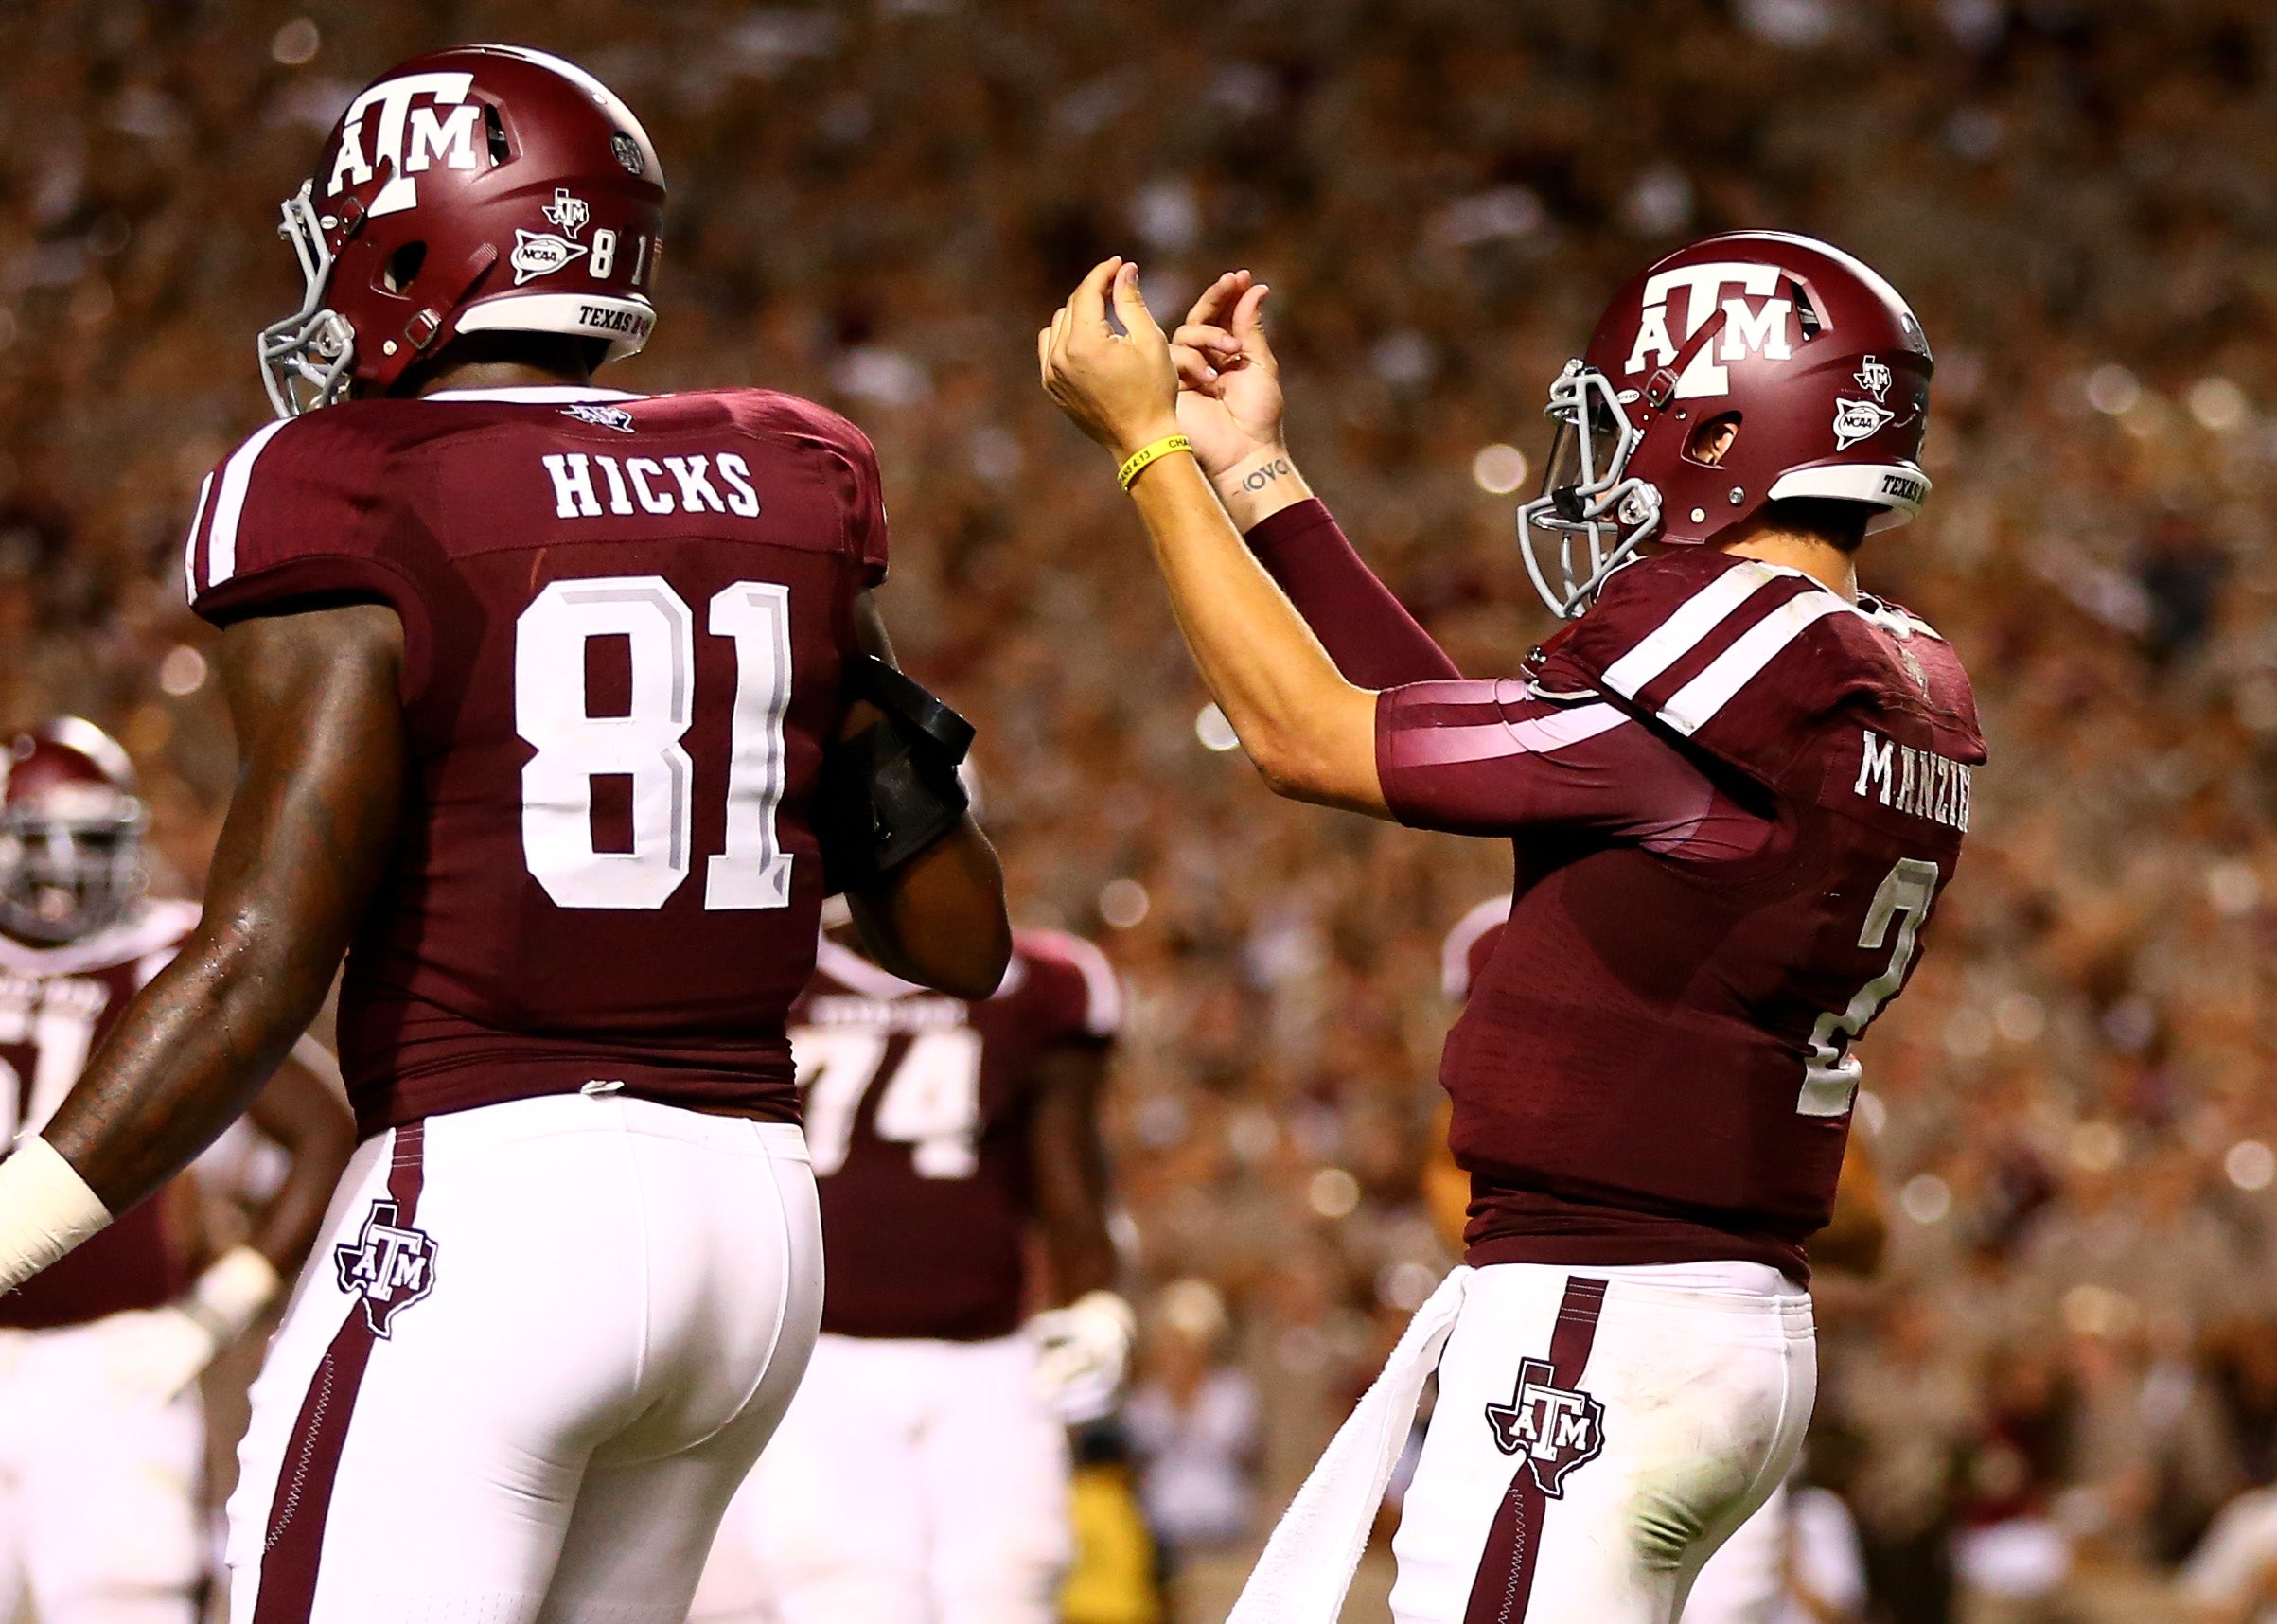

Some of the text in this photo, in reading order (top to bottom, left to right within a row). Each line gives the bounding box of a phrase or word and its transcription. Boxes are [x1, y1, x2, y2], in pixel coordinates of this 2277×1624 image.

[521, 248, 558, 262] NCAA
[579, 305, 632, 332] TEXAS
[1843, 415, 1873, 429] NCAA
[542, 450, 761, 520] HICKS
[1881, 474, 1920, 503] TEXAS
[515, 574, 795, 910] 81
[1796, 857, 1938, 1116] 2
[785, 1020, 985, 1180] 74
